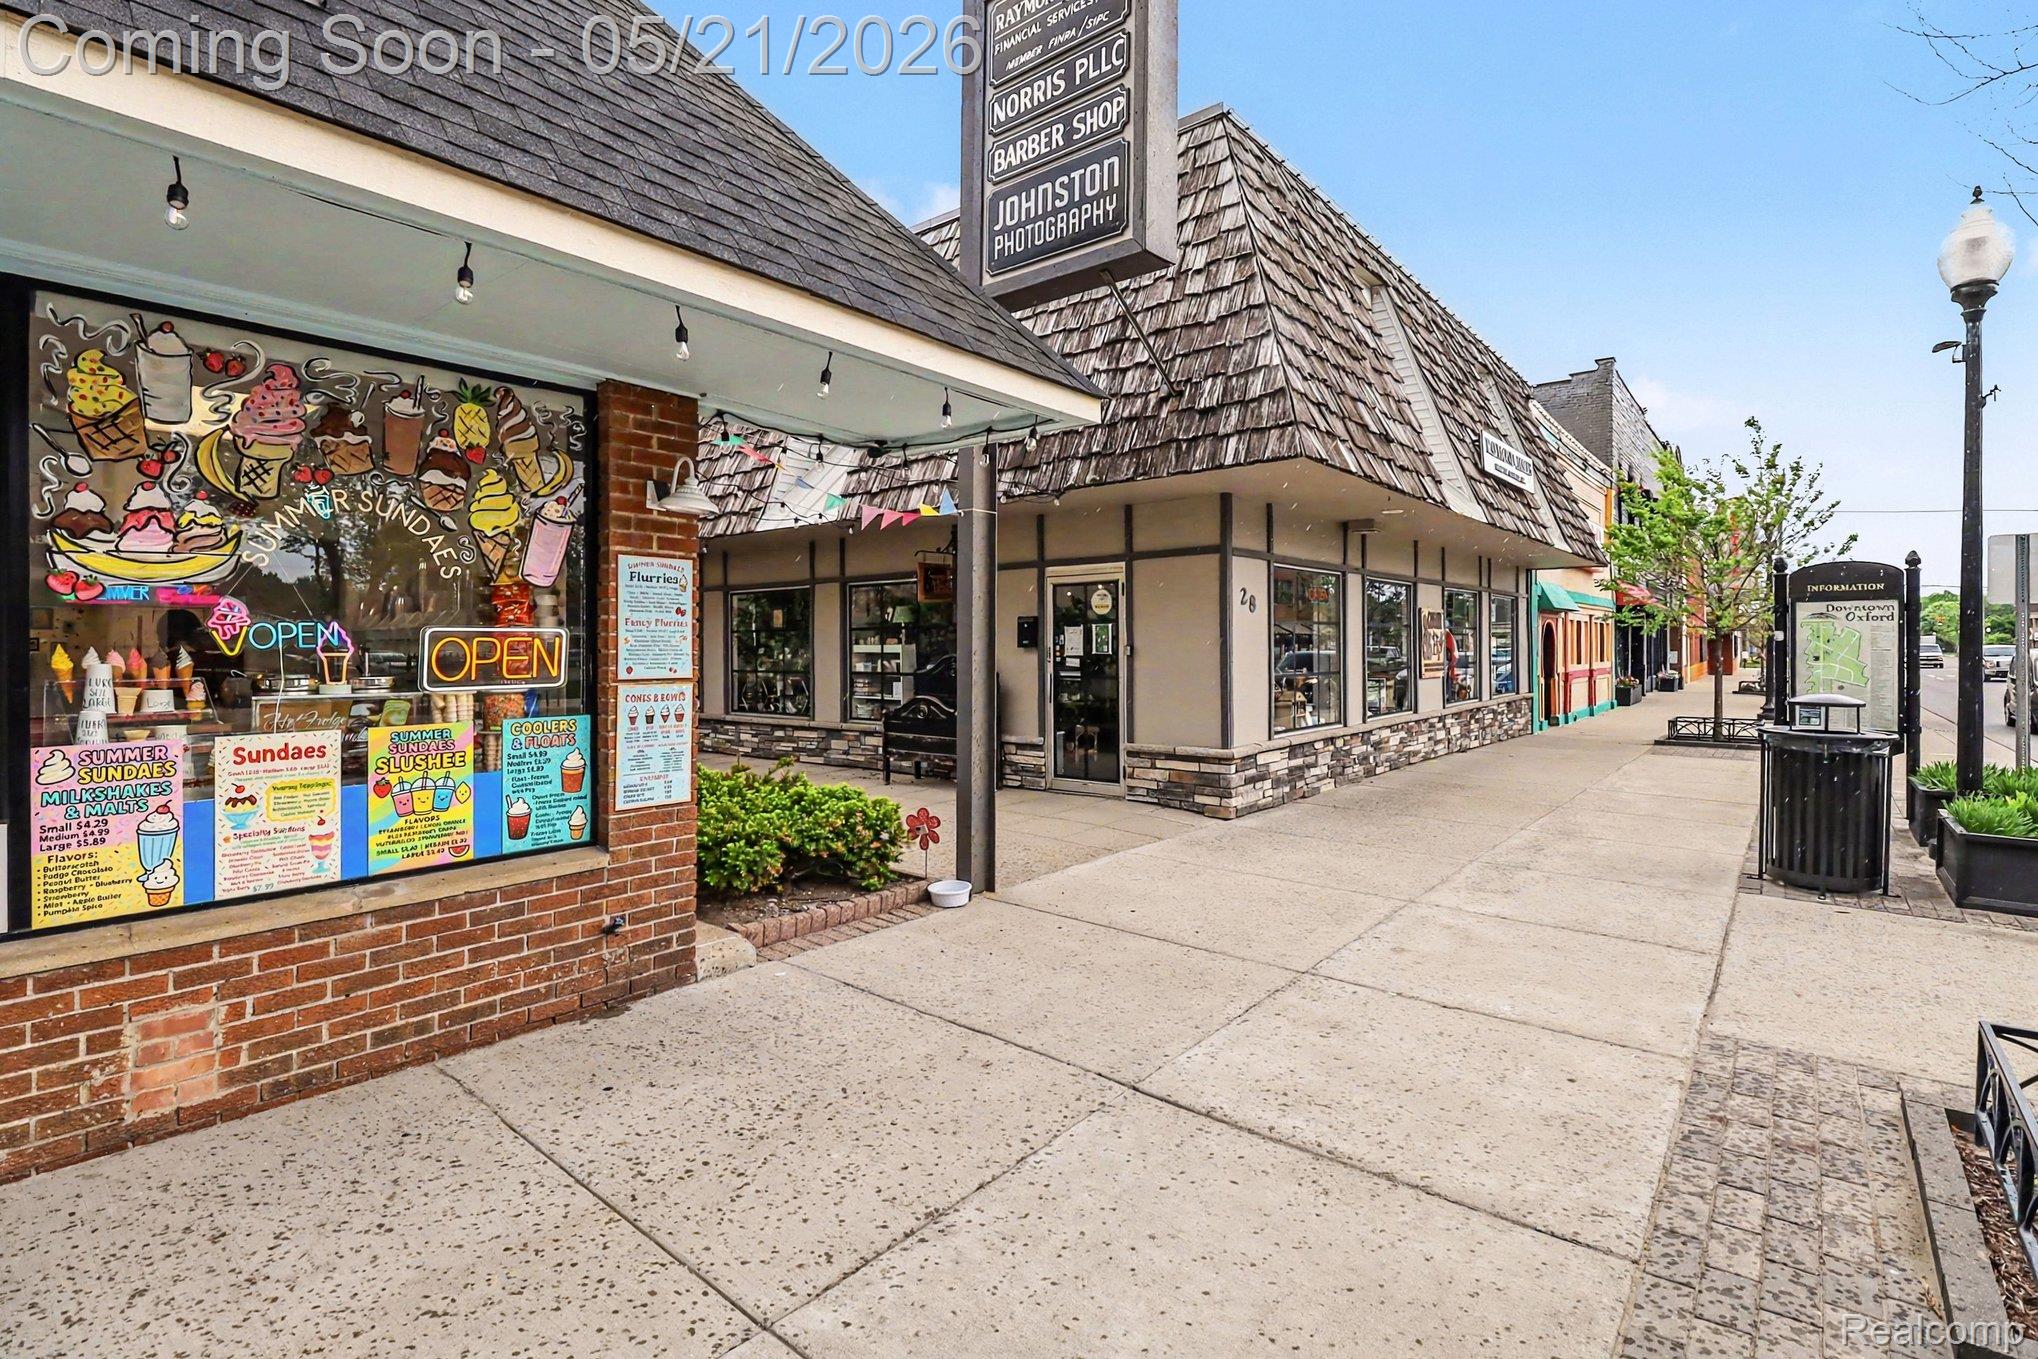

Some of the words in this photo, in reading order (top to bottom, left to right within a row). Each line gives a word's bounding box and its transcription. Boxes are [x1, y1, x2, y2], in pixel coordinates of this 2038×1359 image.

[995, 0, 1052, 34] RAYMO
[994, 22, 1042, 56] FINANCIAL
[1006, 44, 1043, 71] MEMBER
[993, 68, 1066, 126] NORRIS
[1075, 38, 1125, 86] PLLC
[993, 125, 1064, 175] BARBER
[1072, 96, 1125, 140] SHOP
[993, 156, 1120, 232] JOHNSTON
[993, 194, 1117, 261] PHOTOGRAPHY
[358, 489, 462, 580] SUNDAES
[629, 571, 679, 584] Flurries
[1807, 582, 1885, 592] INFORMATION
[1240, 587, 1256, 613] 28
[1826, 603, 1895, 612] Downtown
[1845, 611, 1895, 622] Oxford
[248, 621, 340, 650] OPEN
[430, 636, 560, 683] OPEN
[625, 693, 652, 703] CONES
[390, 728, 452, 744] SUMMER
[510, 718, 577, 736] COOLERS
[388, 739, 455, 755] SUNDAES
[511, 737, 523, 750] &
[524, 733, 577, 750] FLOATS
[78, 745, 168, 766] SUMMER
[233, 742, 327, 766] Sundaes
[375, 751, 466, 775] SLUSHEE
[77, 760, 177, 785] SUNDAES
[41, 781, 173, 807] MILKSHAKES
[64, 805, 80, 820] &
[84, 799, 149, 819] MALTS
[39, 822, 72, 834] Small
[76, 818, 109, 830] $4.29
[39, 833, 79, 843] Medium
[83, 828, 110, 838] $4.99
[40, 842, 73, 852] Large
[76, 837, 106, 848] $5.89
[47, 851, 98, 864] Flavors:
